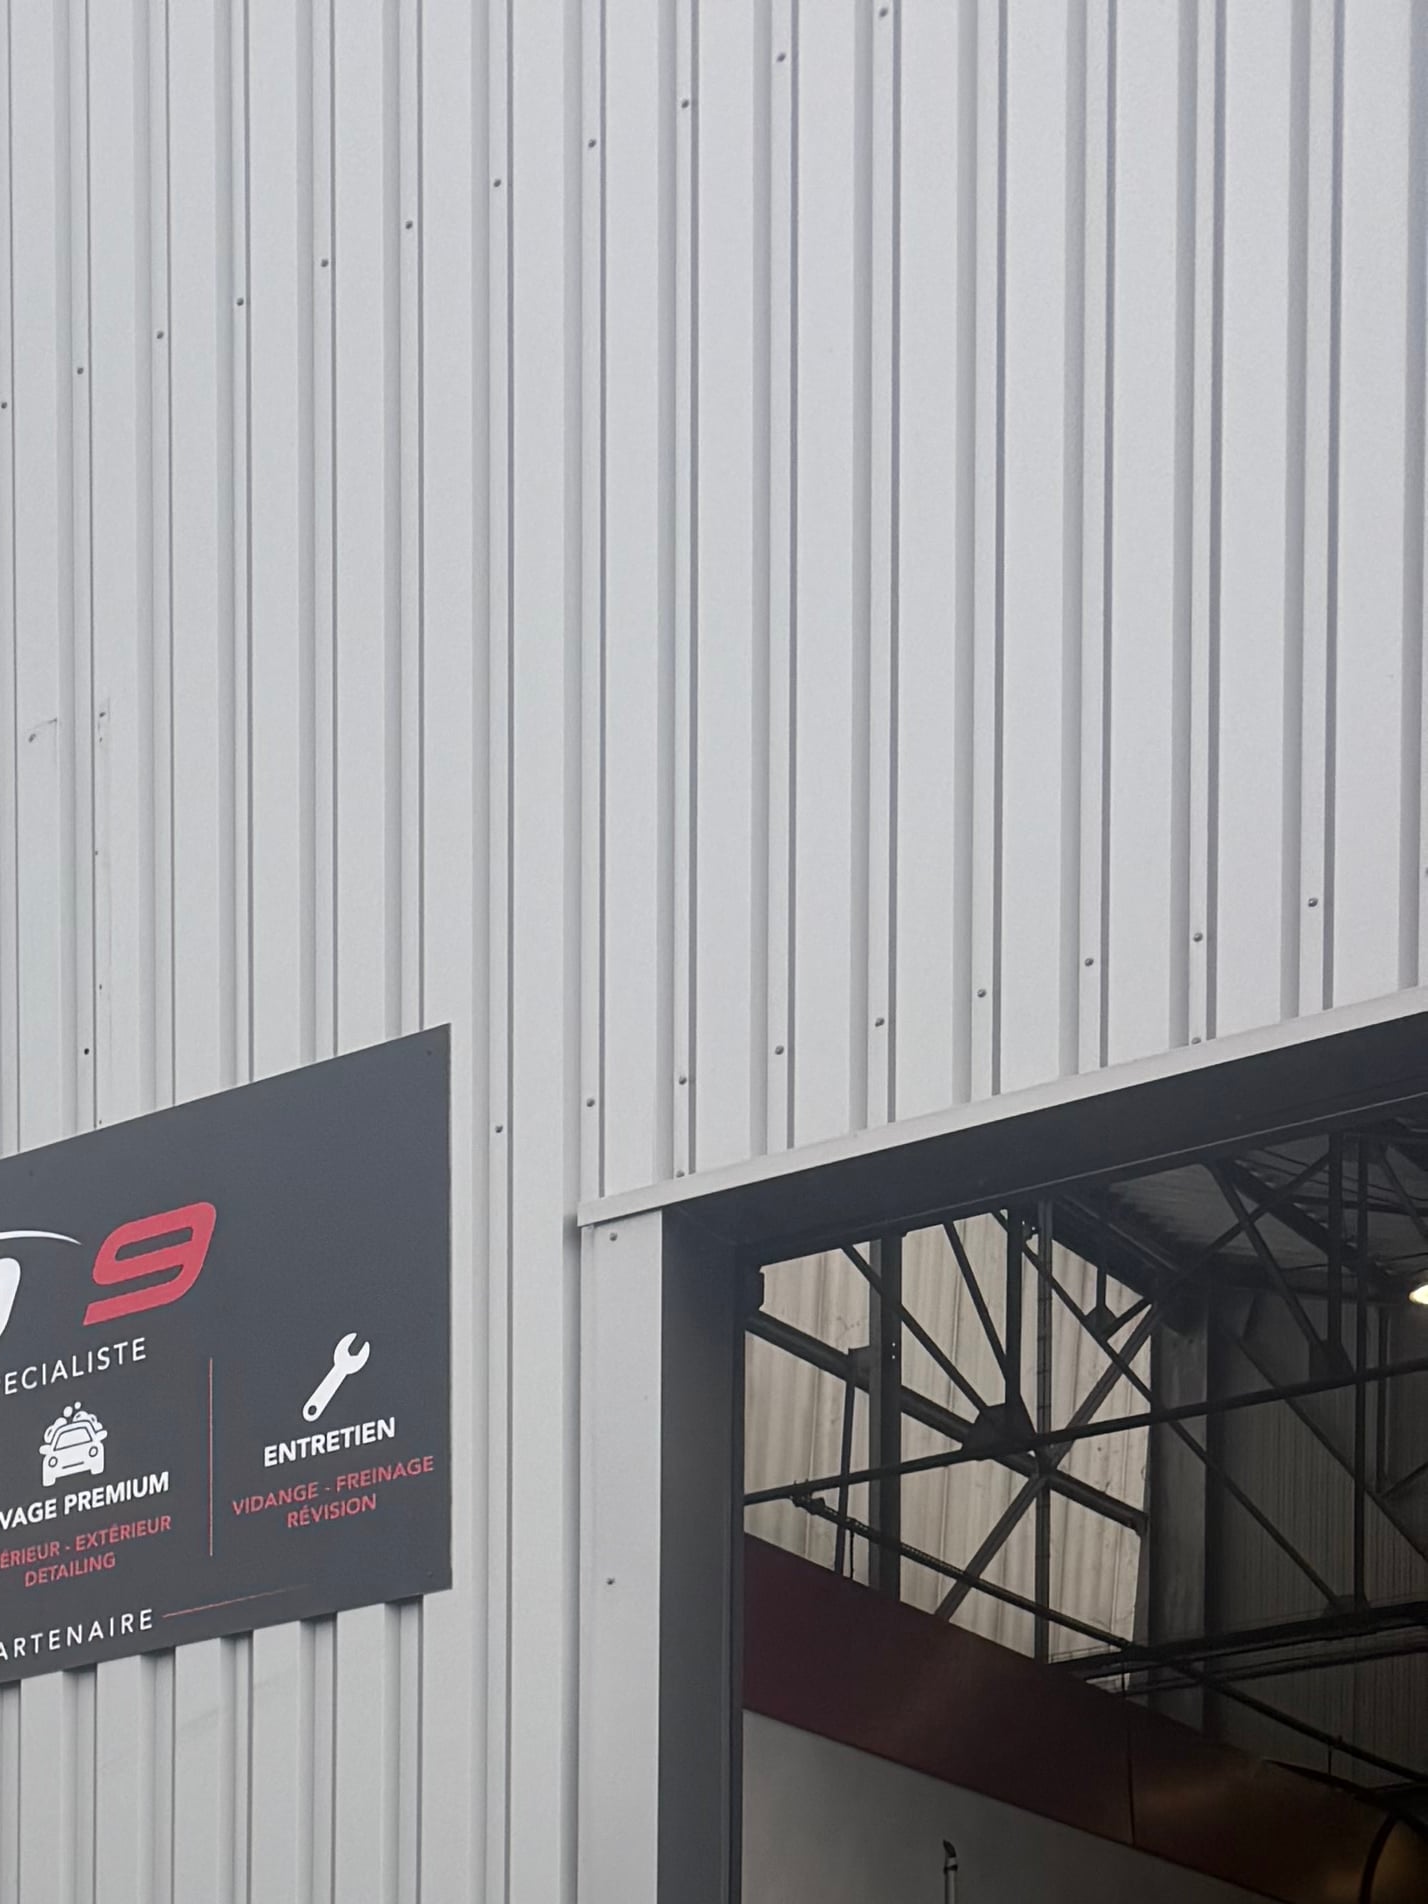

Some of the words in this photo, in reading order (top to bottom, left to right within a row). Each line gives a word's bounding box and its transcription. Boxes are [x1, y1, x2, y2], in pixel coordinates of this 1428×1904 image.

[82, 1201, 216, 1326] 9
[263, 1416, 396, 1467] ENTRETIEN
[63, 1471, 169, 1515] PREMIUM
[231, 1481, 318, 1516] VIDANGE
[336, 1455, 435, 1493] FREINAGE
[287, 1492, 377, 1529] RÉVISION
[75, 1514, 172, 1552] EXTÉRIEUR
[24, 1551, 116, 1588] DETAILING
